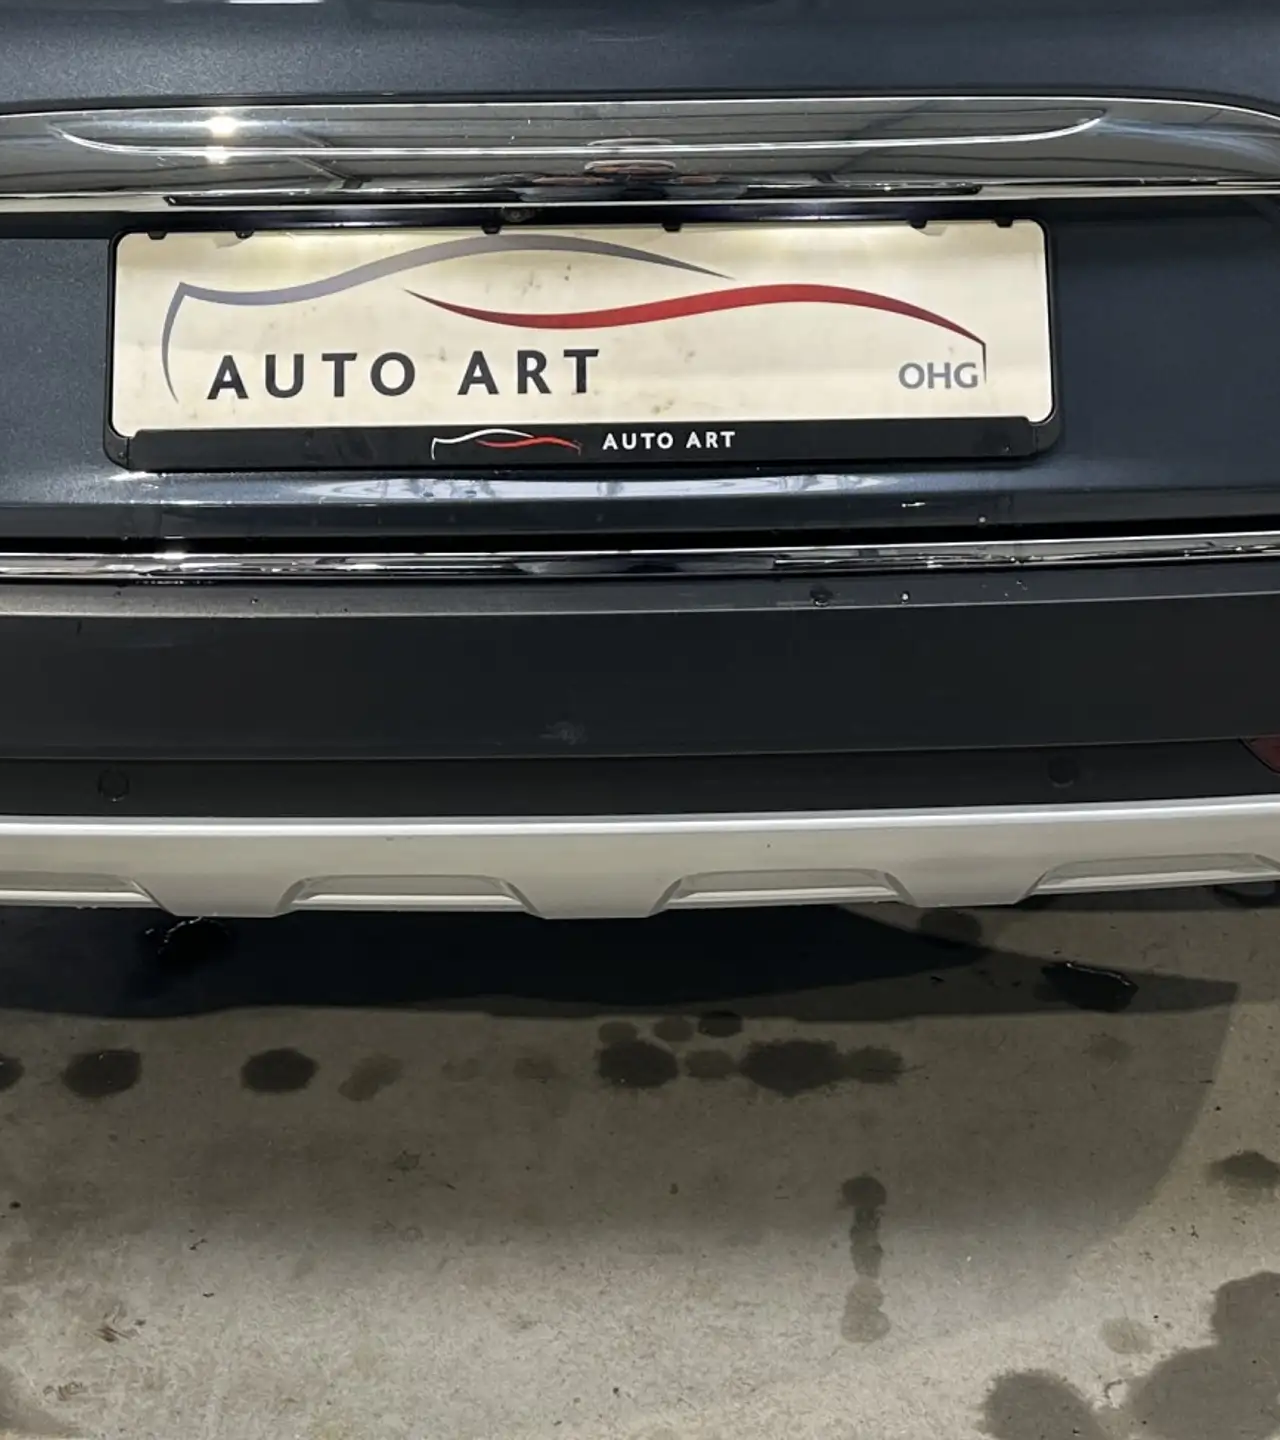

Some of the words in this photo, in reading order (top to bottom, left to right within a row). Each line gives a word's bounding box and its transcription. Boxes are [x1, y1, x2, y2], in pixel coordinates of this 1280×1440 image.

[207, 351, 416, 400] AUTO
[457, 348, 600, 395] ART
[898, 362, 978, 389] OHG
[602, 431, 674, 451] AUTO
[686, 430, 736, 449] ART
